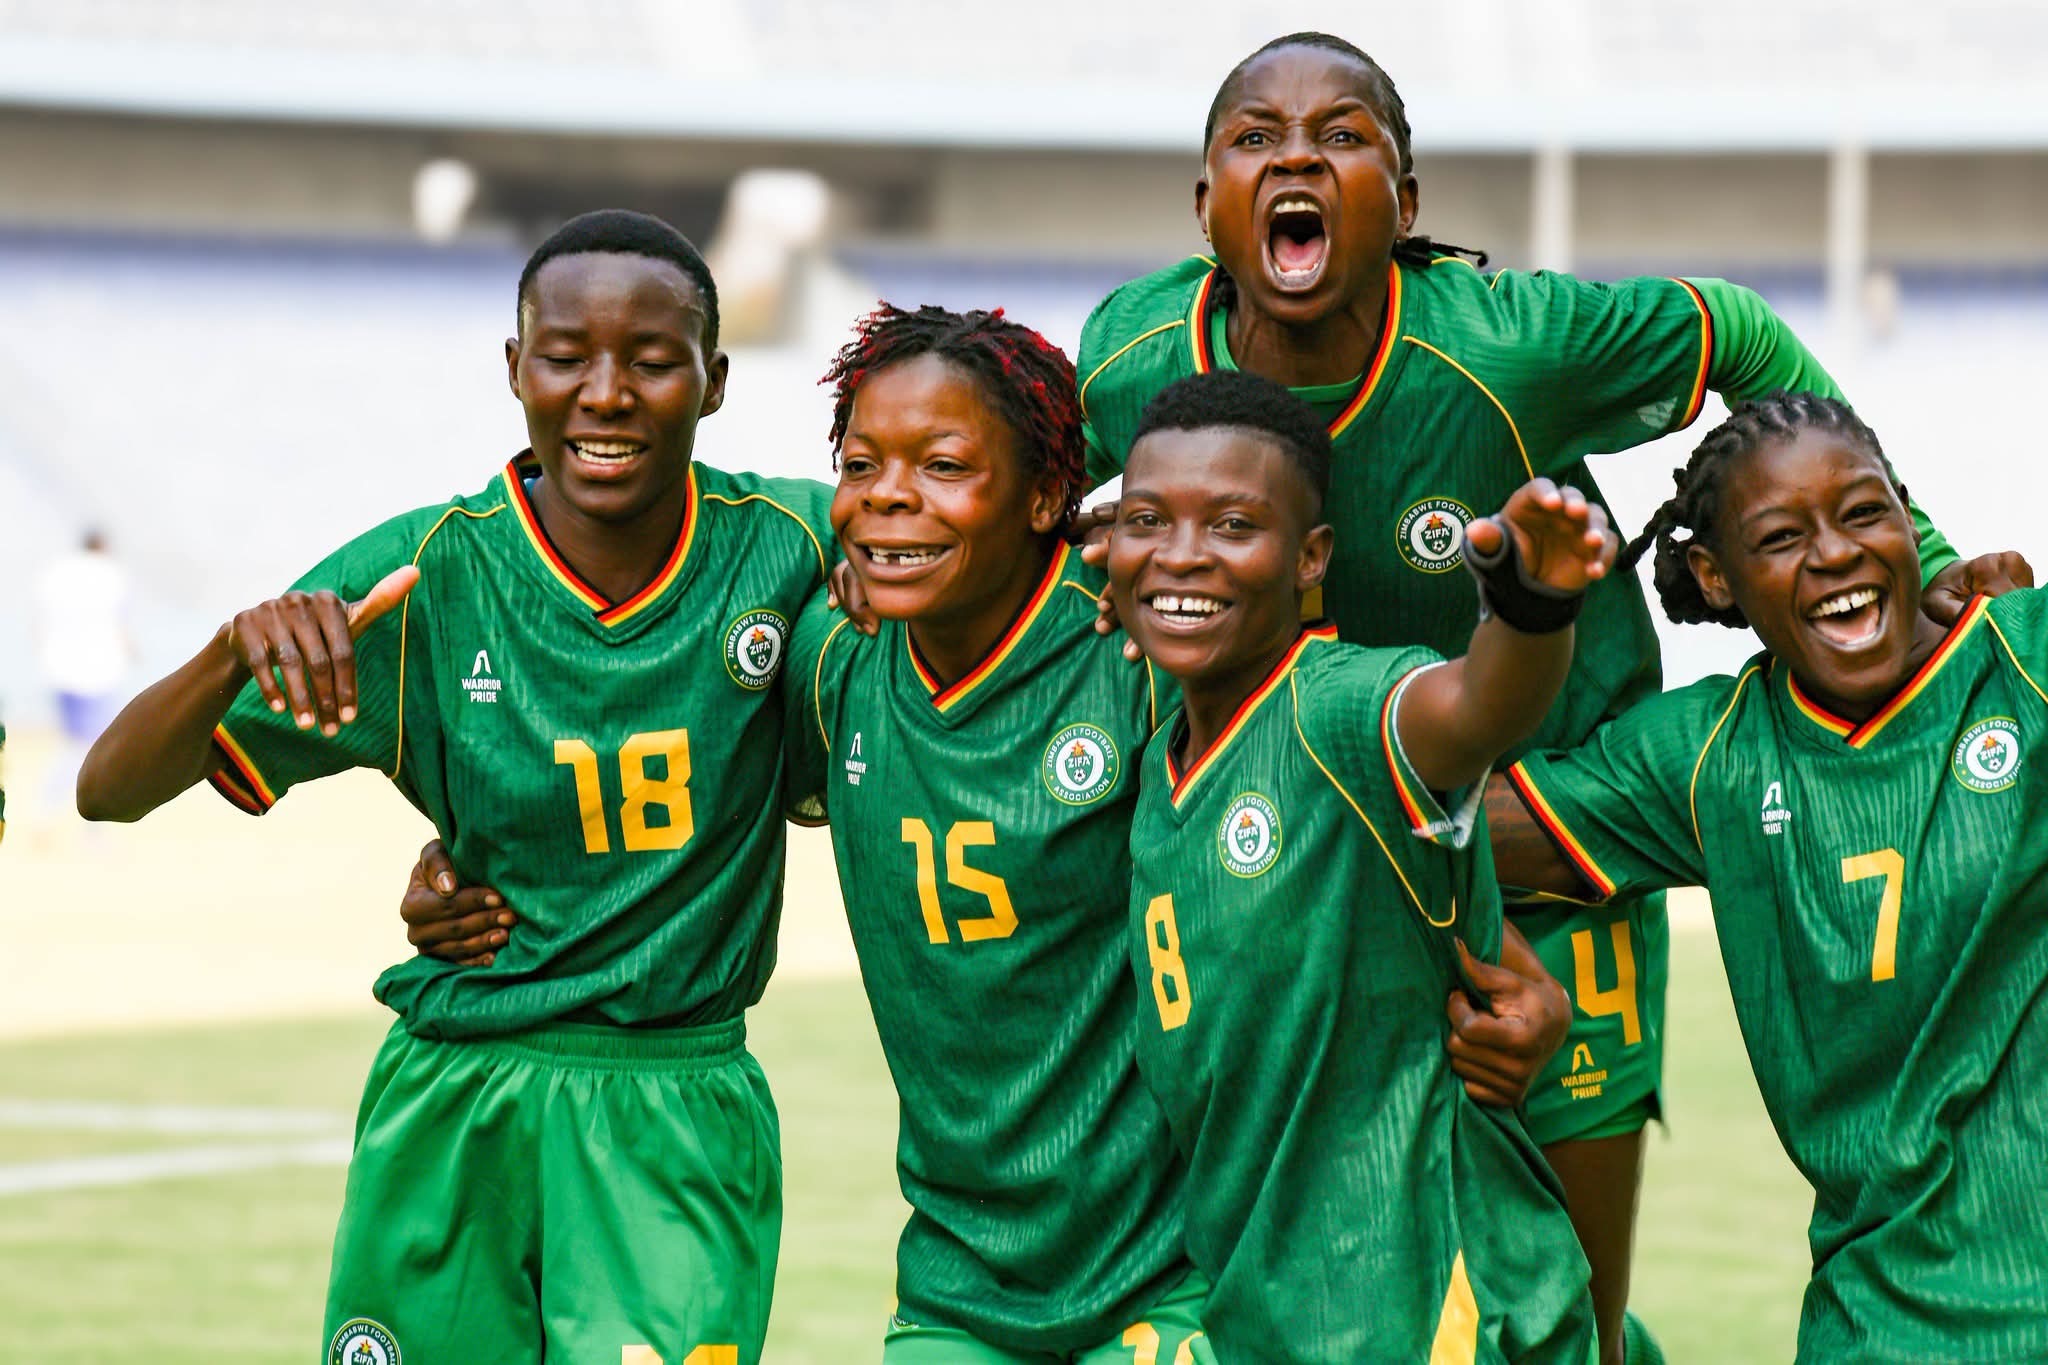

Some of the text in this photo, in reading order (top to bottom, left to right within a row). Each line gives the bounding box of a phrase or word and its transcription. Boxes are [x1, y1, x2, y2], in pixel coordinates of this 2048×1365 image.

[1400, 501, 1471, 540] ZIMBABWE FOOTBAL
[1424, 527, 1450, 540] ZIFA
[728, 615, 755, 659] ZIMBABWE
[749, 640, 771, 656] ZIFA
[461, 678, 502, 691] WARRIOR
[470, 691, 497, 703] PRIDE
[1047, 727, 1114, 769] ZIMBABWE FOOTBALL
[1956, 723, 1987, 765] ZIMBABWE
[1980, 744, 2005, 761] ZIFA
[1067, 755, 1091, 768] ZIFA
[554, 728, 695, 854] 18
[1053, 778, 1110, 801] ASSOCIATION
[1221, 797, 1277, 841] ZIMBABWE FOOTBALL
[1237, 825, 1258, 840] ZIFA
[1227, 847, 1276, 874] ASSOCIATION
[901, 817, 1019, 944] 15
[1841, 848, 1905, 982] 7
[1145, 893, 1191, 1032] 8
[1571, 920, 1642, 1046] 4
[1561, 1069, 1608, 1088] WARRIOR
[1572, 1084, 1602, 1101] PRIDE
[335, 1325, 369, 1352] ZIMBABWE
[353, 1352, 374, 1365] ZIFA
